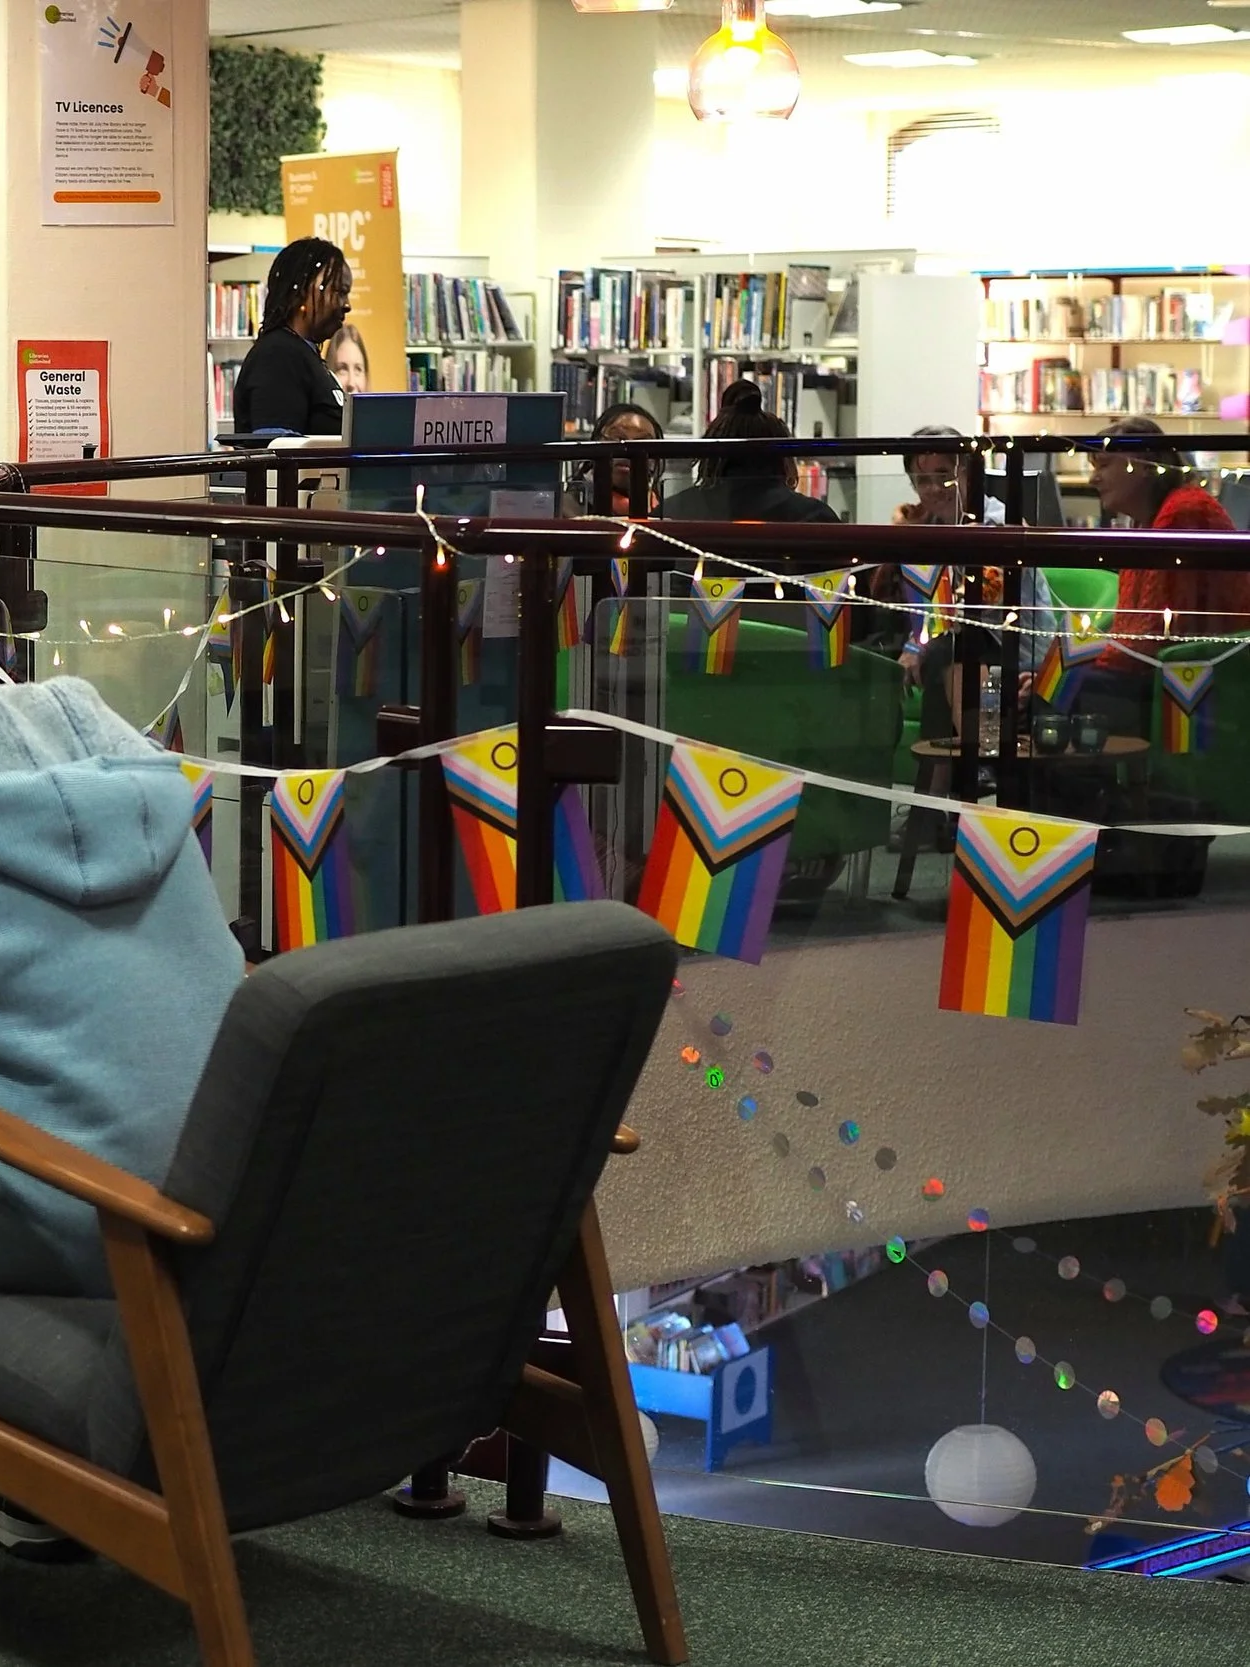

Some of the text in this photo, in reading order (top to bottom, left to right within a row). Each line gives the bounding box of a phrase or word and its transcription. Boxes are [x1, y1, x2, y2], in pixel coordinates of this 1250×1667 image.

[55, 101, 124, 113] TV Licences
[40, 371, 85, 382] General
[44, 385, 81, 395] Waste
[423, 420, 494, 444] PRINTER
